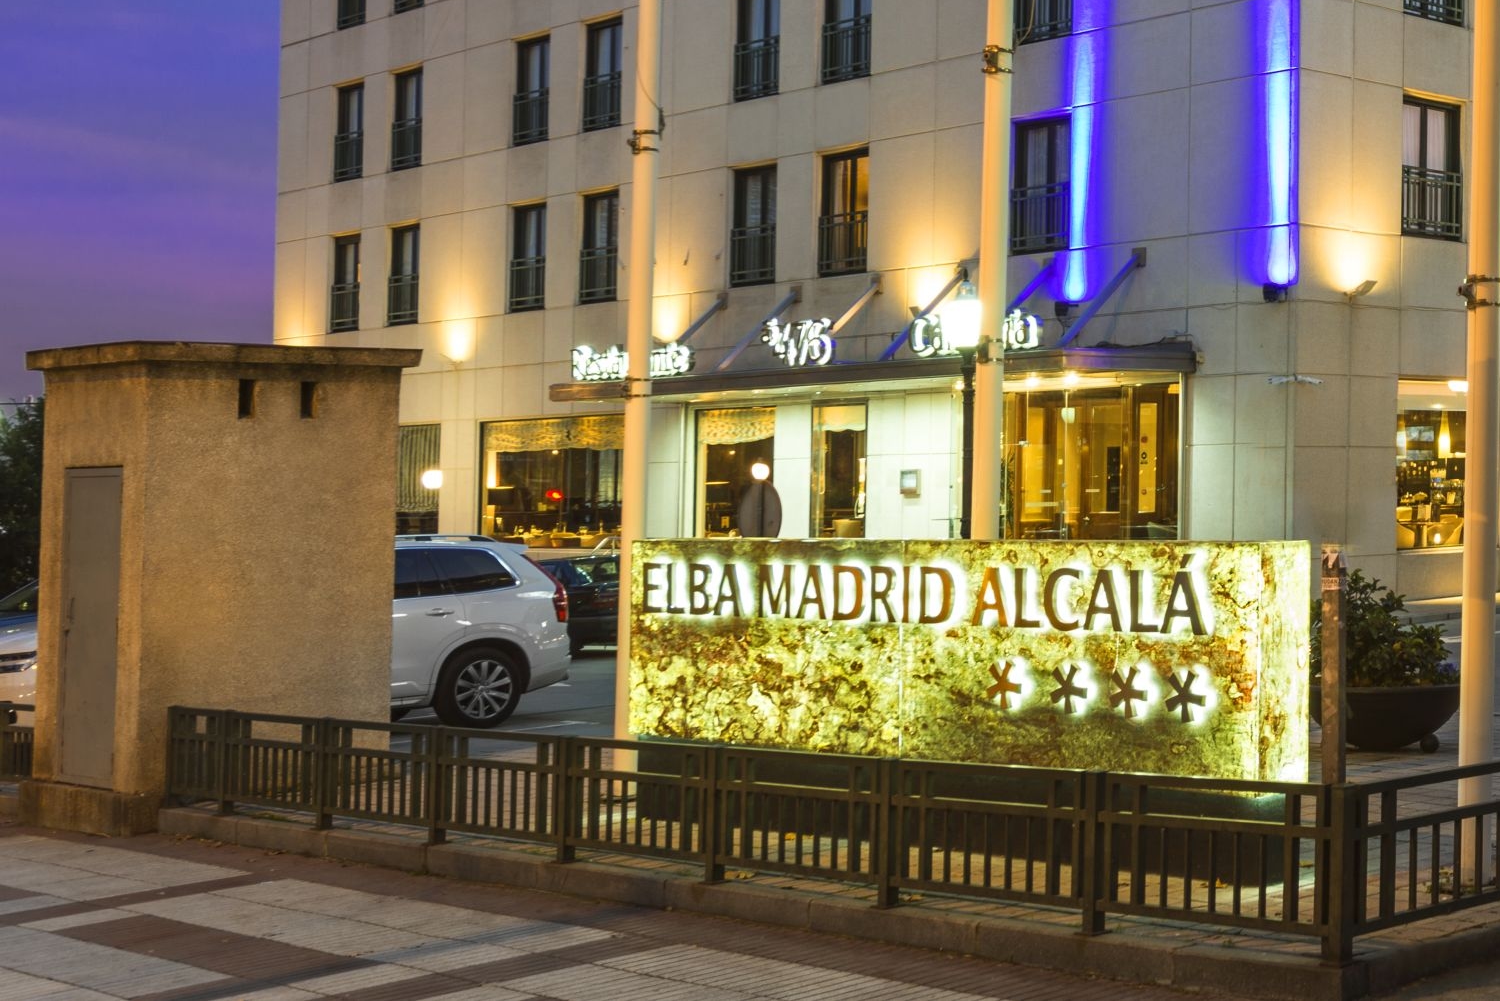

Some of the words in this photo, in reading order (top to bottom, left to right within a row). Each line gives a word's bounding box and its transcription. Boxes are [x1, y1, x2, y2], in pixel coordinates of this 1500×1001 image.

[643, 561, 742, 616] ELBA
[757, 562, 953, 624] MADRID
[974, 553, 1213, 637] ALCALÁ
